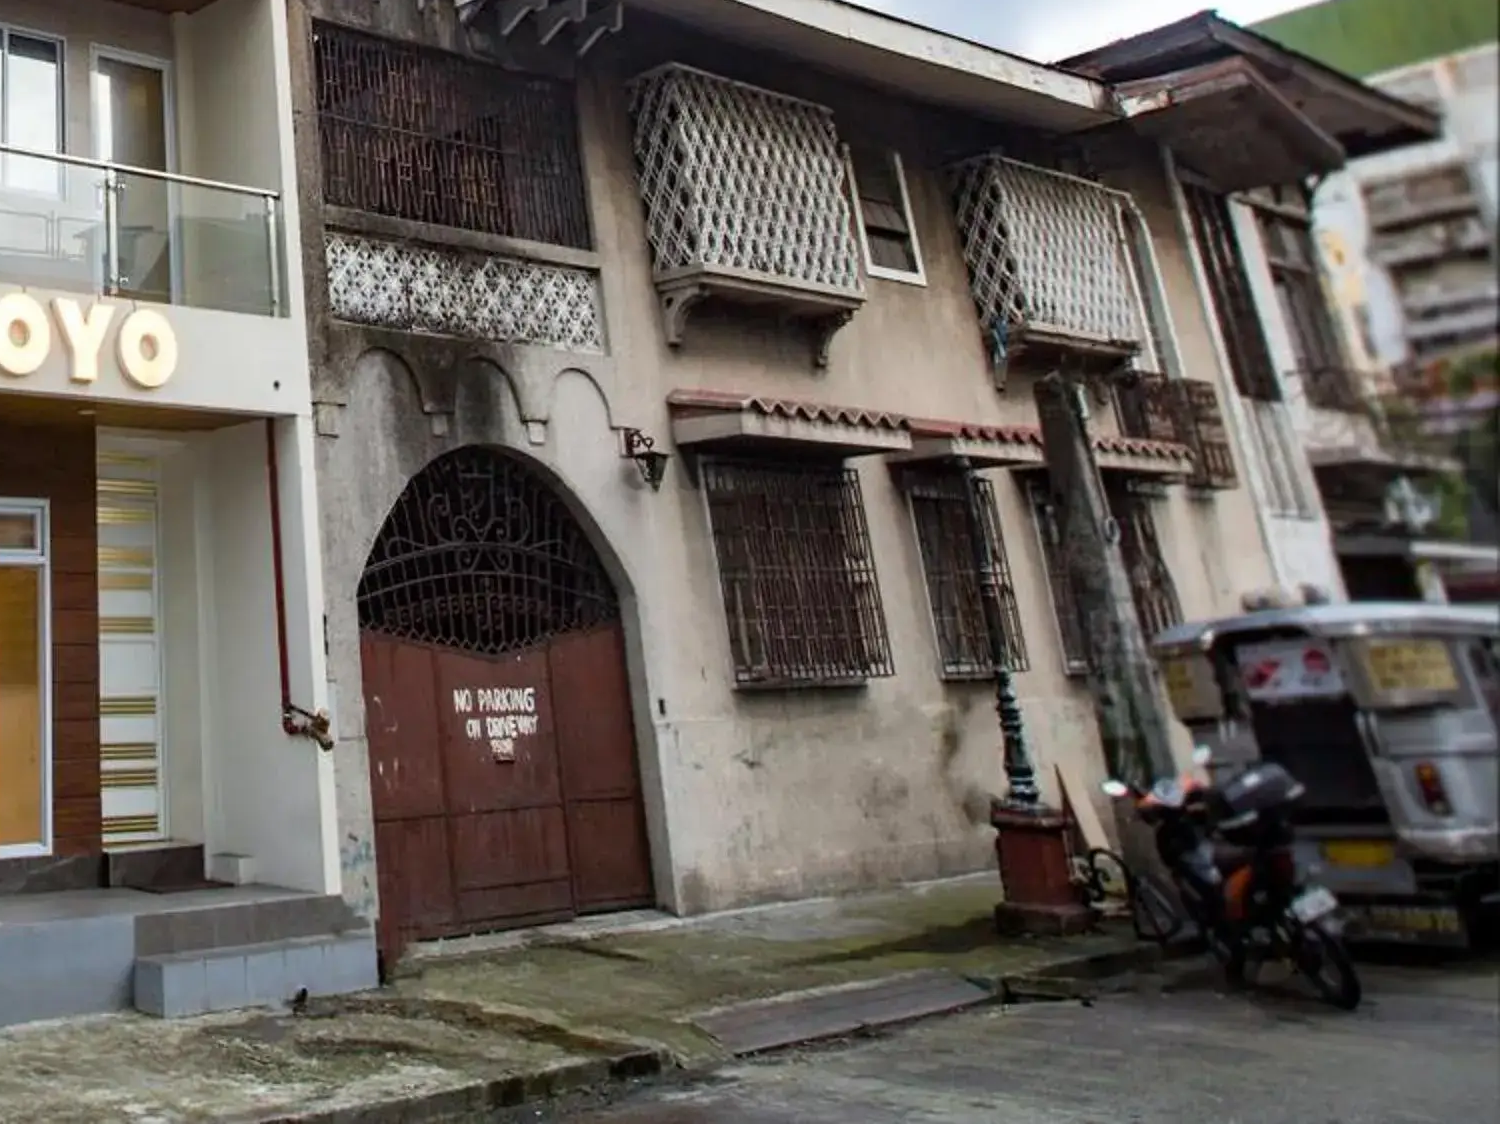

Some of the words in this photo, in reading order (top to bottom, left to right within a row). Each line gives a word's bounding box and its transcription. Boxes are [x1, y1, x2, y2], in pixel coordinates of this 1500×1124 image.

[453, 687, 472, 713] NO
[477, 686, 535, 713] PARKING
[466, 719, 481, 740] ON
